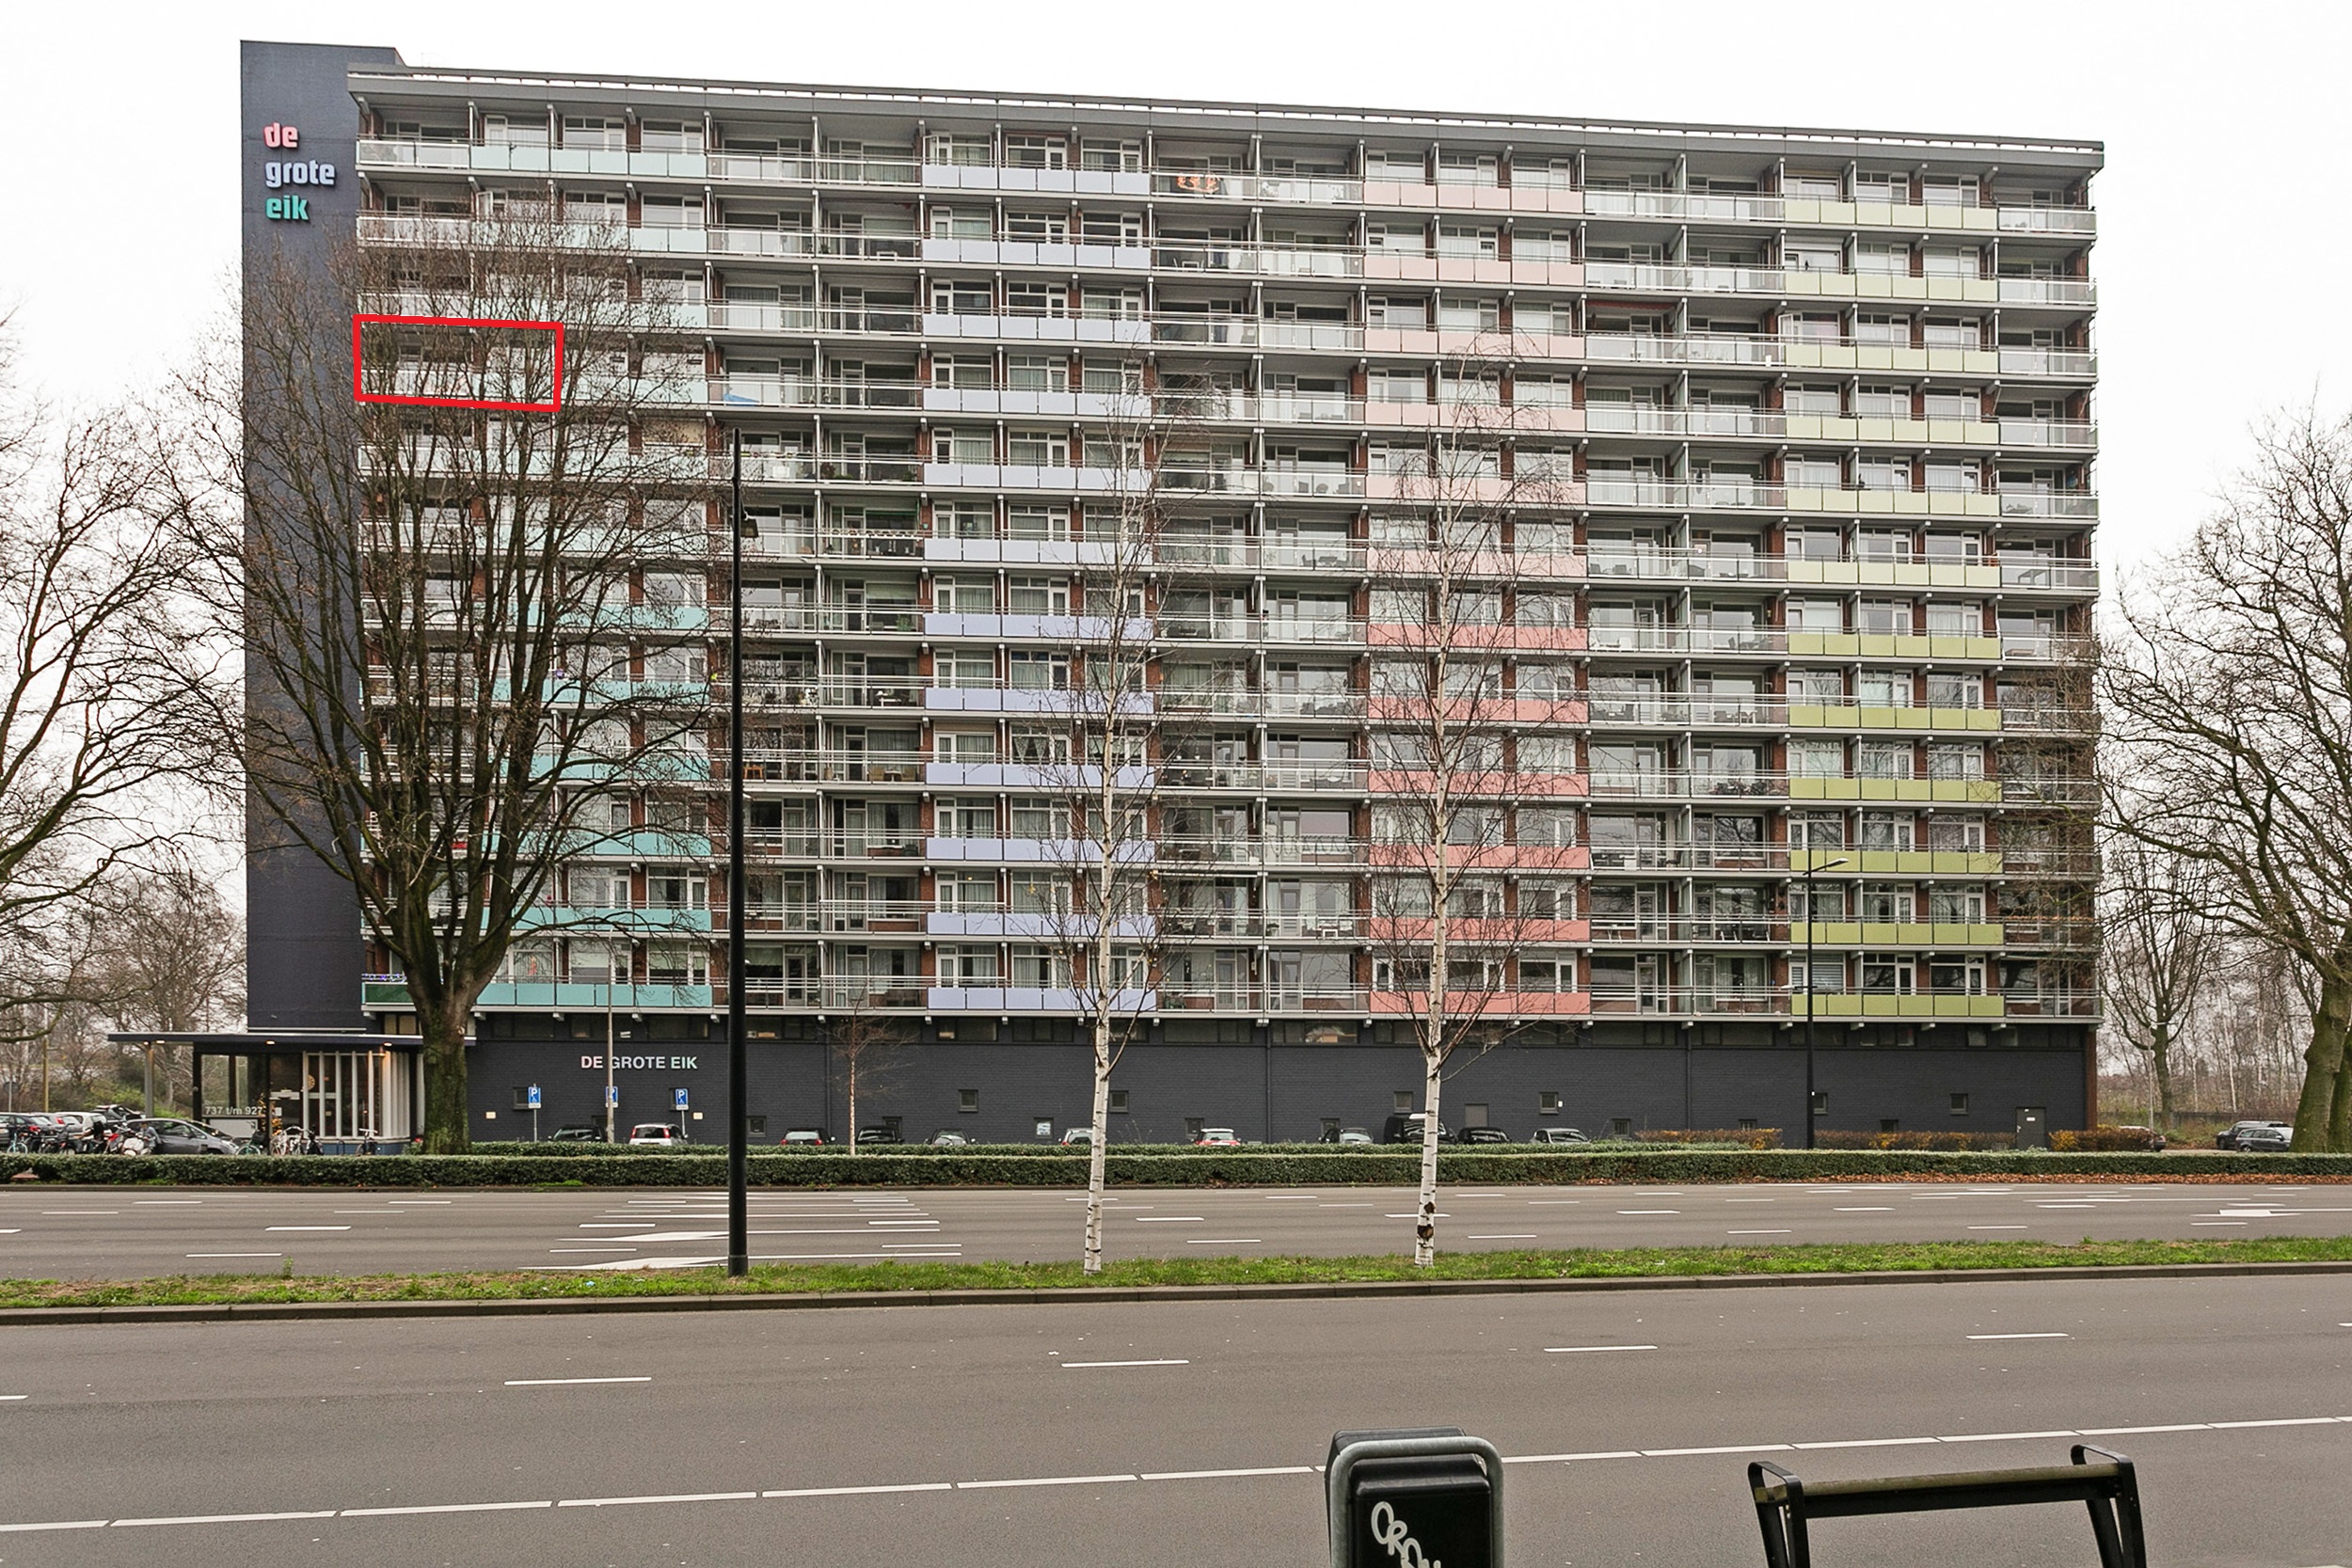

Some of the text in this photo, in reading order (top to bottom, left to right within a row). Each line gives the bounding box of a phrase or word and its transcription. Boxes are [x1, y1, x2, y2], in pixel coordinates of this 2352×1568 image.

[263, 121, 298, 149] de
[265, 159, 335, 188] grote
[265, 195, 309, 220] eik
[580, 1055, 698, 1069] DE GROTE EIK
[205, 1106, 223, 1116] 737
[245, 1106, 262, 1116] 927
